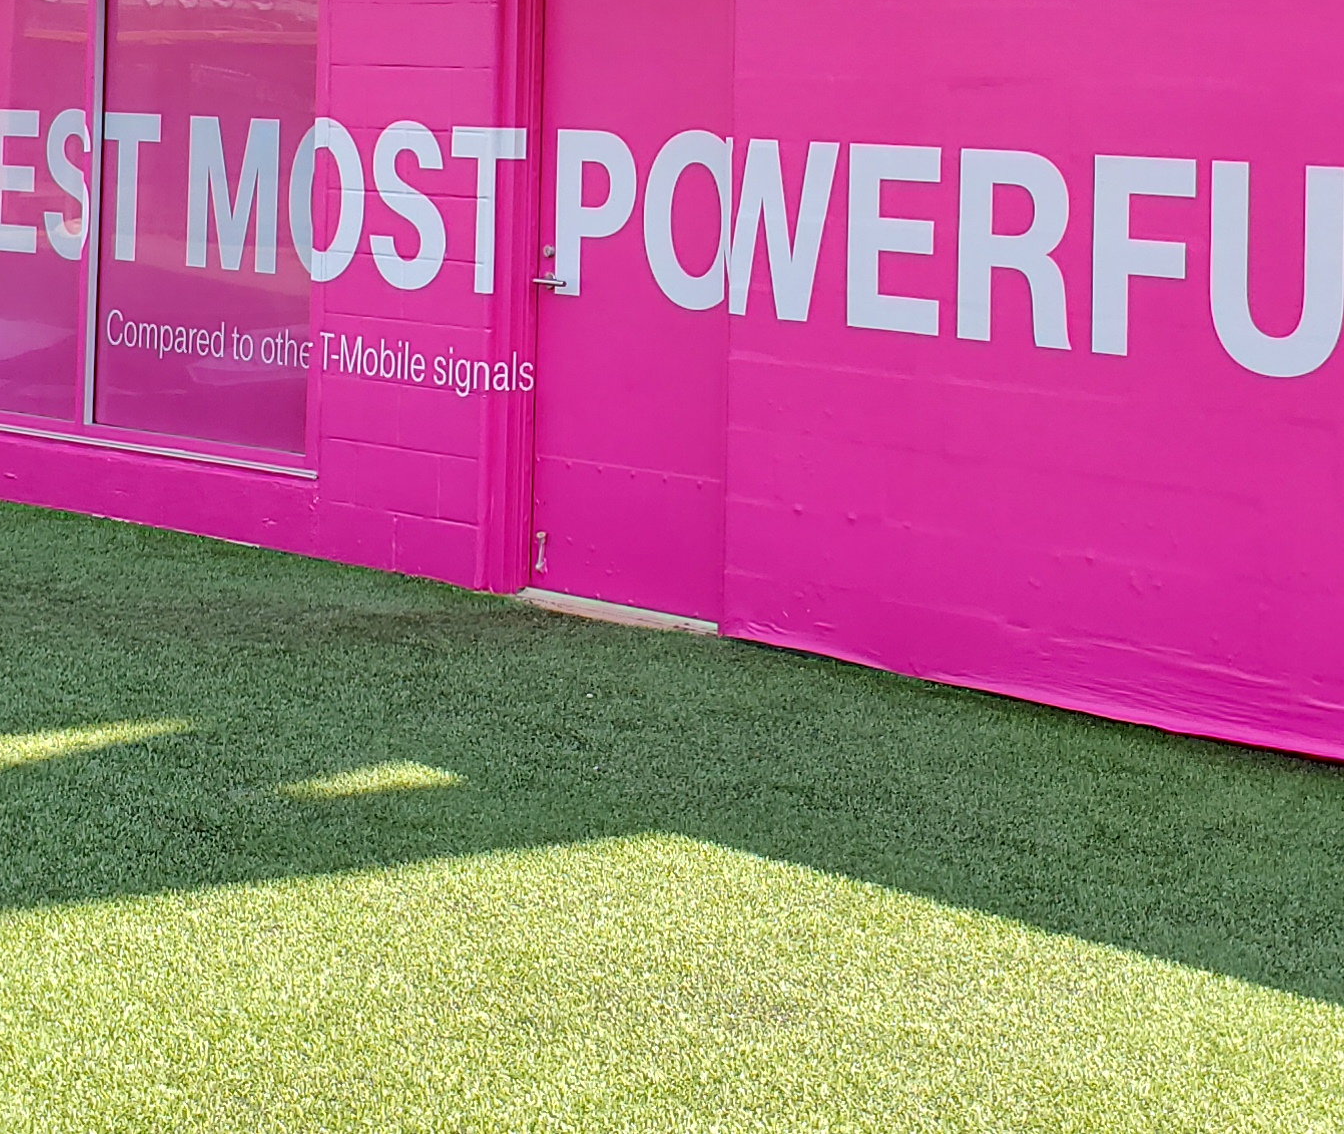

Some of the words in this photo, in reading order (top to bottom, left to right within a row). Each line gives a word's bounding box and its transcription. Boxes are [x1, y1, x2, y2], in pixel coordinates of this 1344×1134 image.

[186, 116, 527, 295] MOST
[106, 309, 225, 358] Compared
[232, 326, 254, 361] to
[261, 329, 314, 370] othe
[320, 331, 426, 382] T-Mobile
[434, 348, 535, 397] signals
